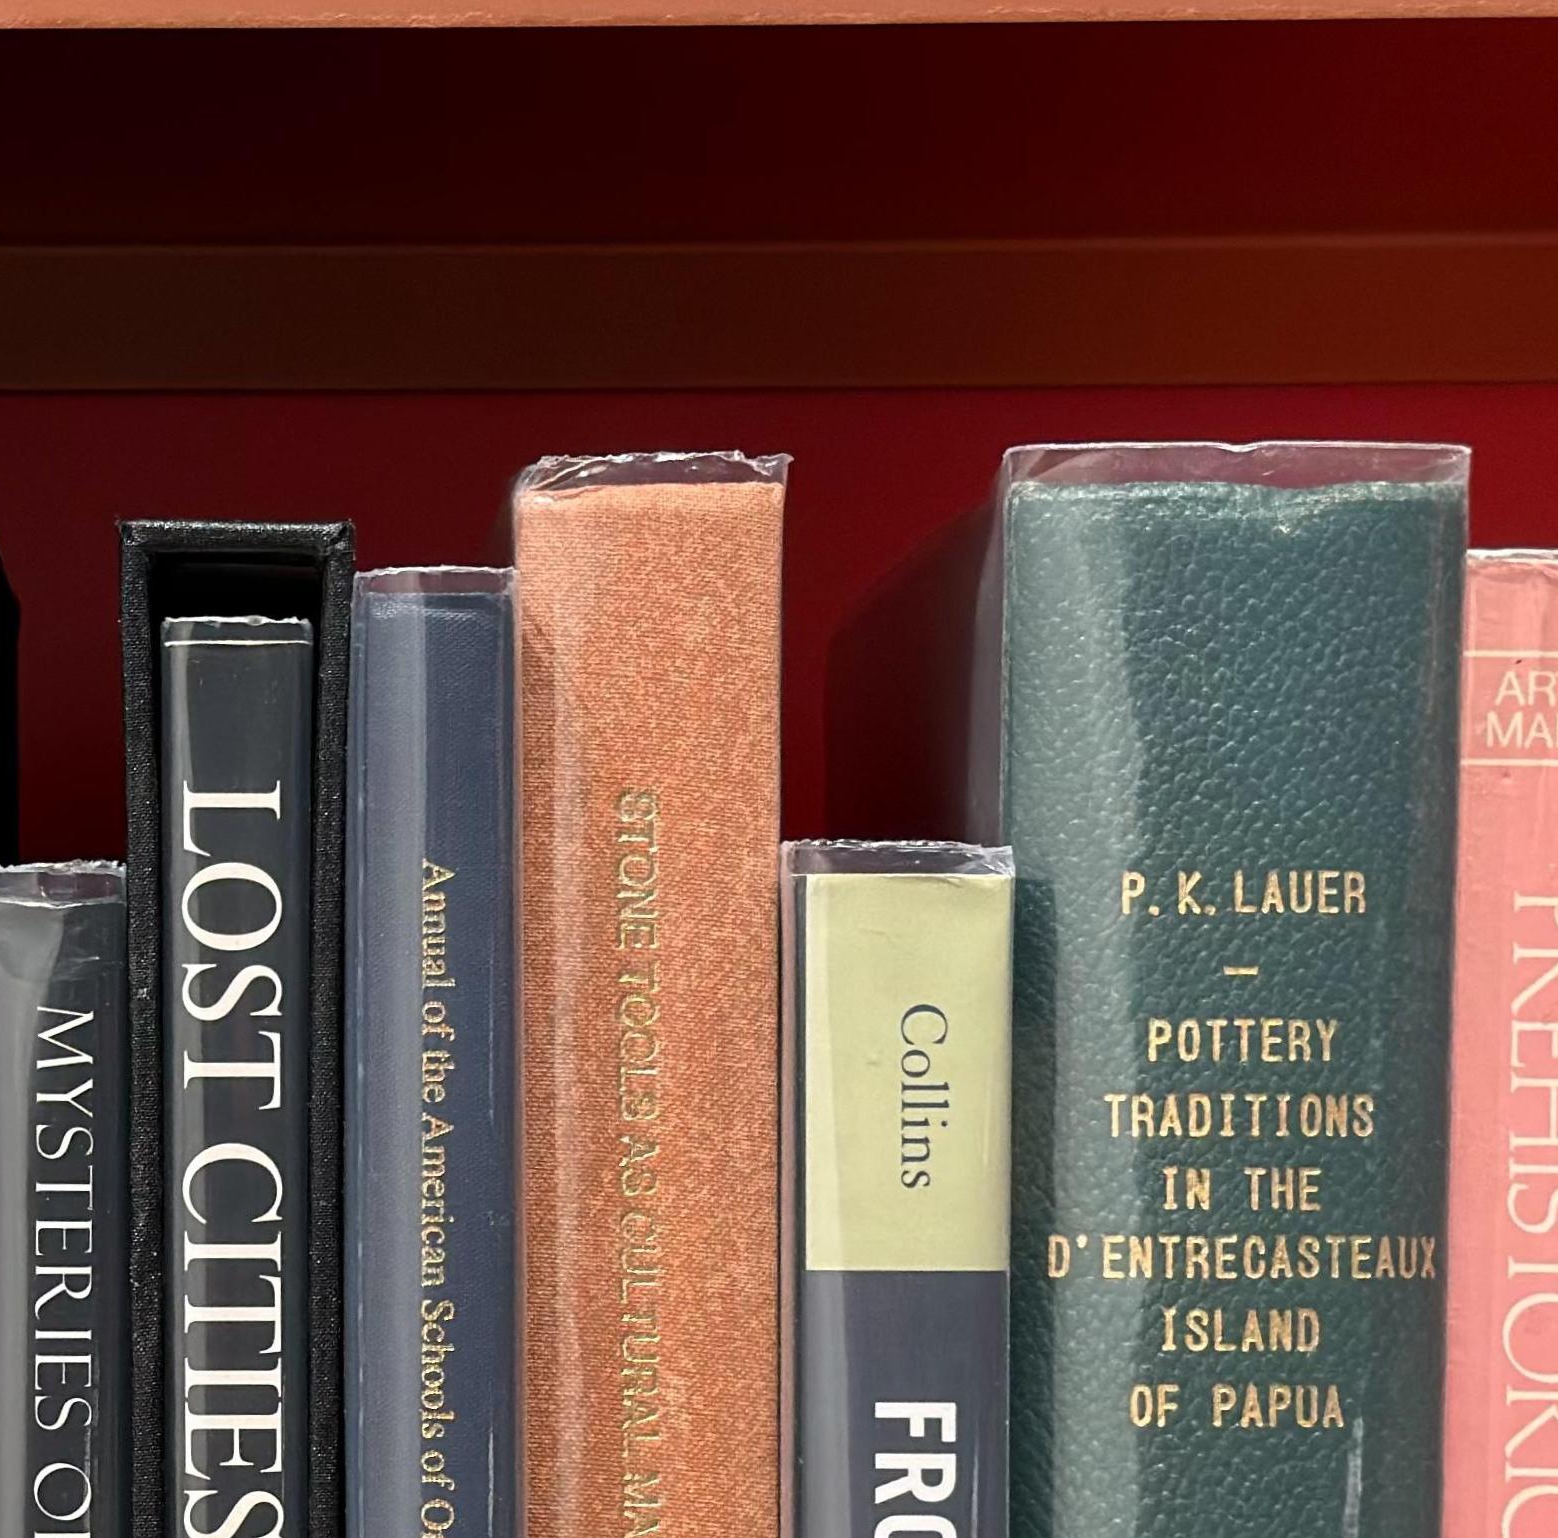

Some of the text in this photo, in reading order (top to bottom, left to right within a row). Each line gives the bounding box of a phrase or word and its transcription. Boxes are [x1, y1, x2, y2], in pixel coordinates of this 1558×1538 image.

[1120, 868, 1367, 916] P. K. LAUER
[180, 779, 284, 1112] LOST
[420, 857, 457, 989] Annual
[420, 999, 456, 1042] of
[1146, 1017, 1338, 1063] POTTERY
[420, 1049, 457, 1103] the
[898, 1002, 950, 1189] Collins
[1103, 1092, 1375, 1138] TRADITIONS
[419, 1111, 456, 1288] American
[1161, 1165, 1323, 1212] IN THE
[33, 1004, 94, 1432] MYSTERIES
[1047, 1233, 1436, 1280] D'ENTRECASTEAUX
[1160, 1306, 1320, 1353] ISLAND
[419, 1298, 456, 1440] Schools
[1128, 1383, 1345, 1429] OF PAPUA
[419, 1449, 456, 1491] of
